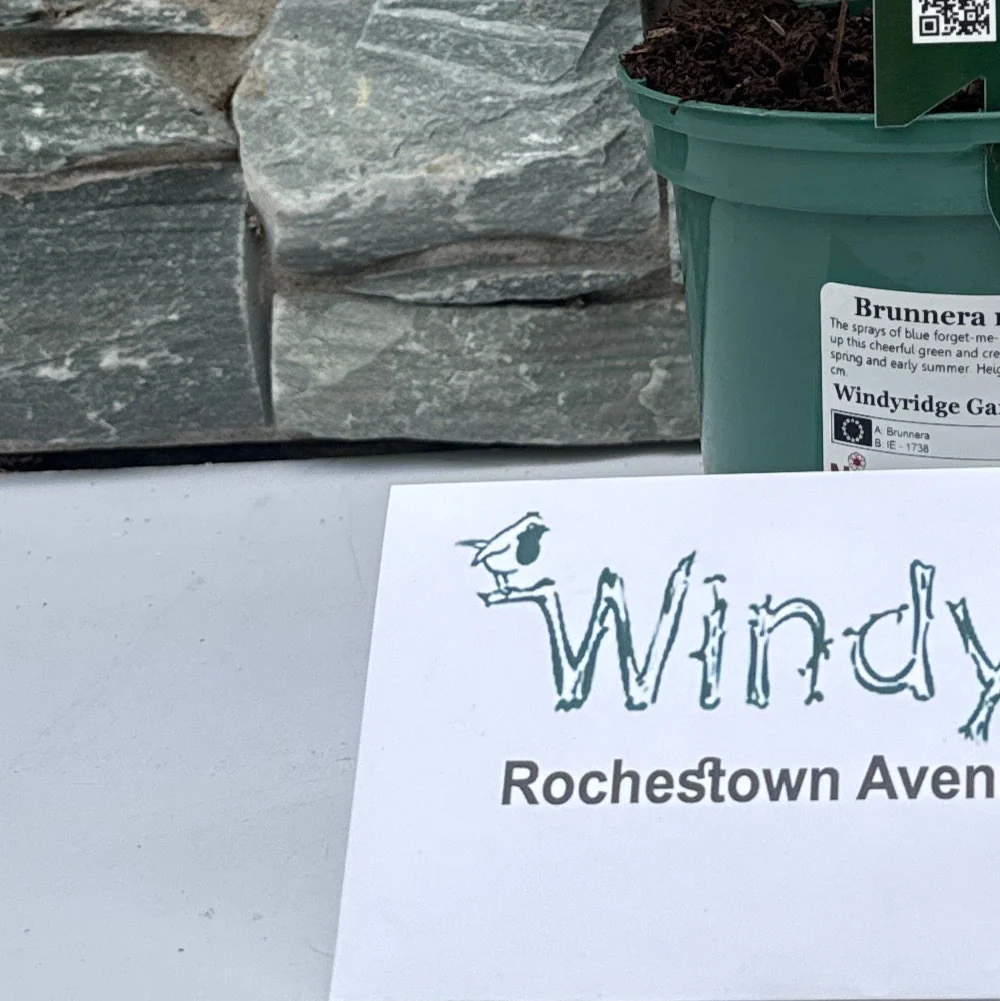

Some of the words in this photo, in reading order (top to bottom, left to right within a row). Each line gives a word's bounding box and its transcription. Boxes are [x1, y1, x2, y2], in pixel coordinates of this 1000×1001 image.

[854, 296, 986, 326] Brunnera
[830, 316, 849, 330] The
[852, 323, 886, 337] sprays
[889, 326, 901, 338] of
[905, 328, 930, 340] blue
[830, 335, 844, 347] up
[847, 337, 866, 349] this
[869, 340, 915, 354] cheerful
[918, 347, 952, 358] green
[956, 347, 978, 358] and
[830, 350, 862, 366] spring
[866, 356, 887, 367] and
[890, 359, 918, 373] early
[833, 383, 960, 418] Windyridge
[886, 427, 930, 440] Brunnera
[906, 443, 929, 453] 1738
[501, 756, 840, 805] Rochestown
